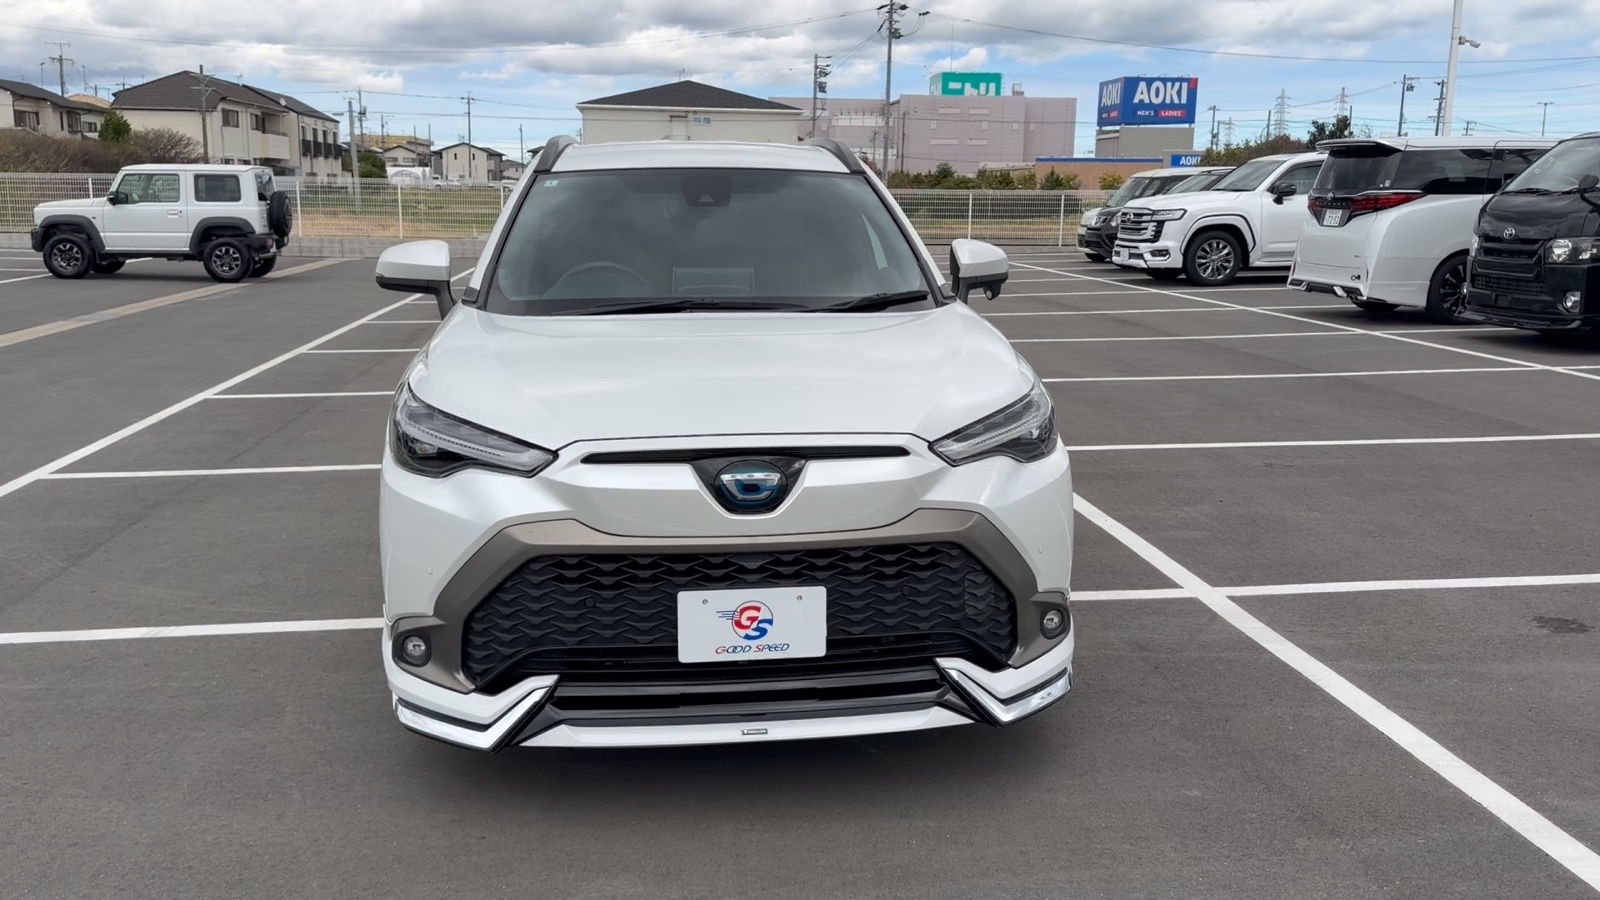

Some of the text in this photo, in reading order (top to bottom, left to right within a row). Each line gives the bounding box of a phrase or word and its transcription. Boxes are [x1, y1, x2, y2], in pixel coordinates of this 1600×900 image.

[1101, 82, 1120, 107] AOKI
[1132, 81, 1188, 104] AOKI
[733, 605, 774, 641] GS
[715, 643, 790, 654] GOOD SPEED
